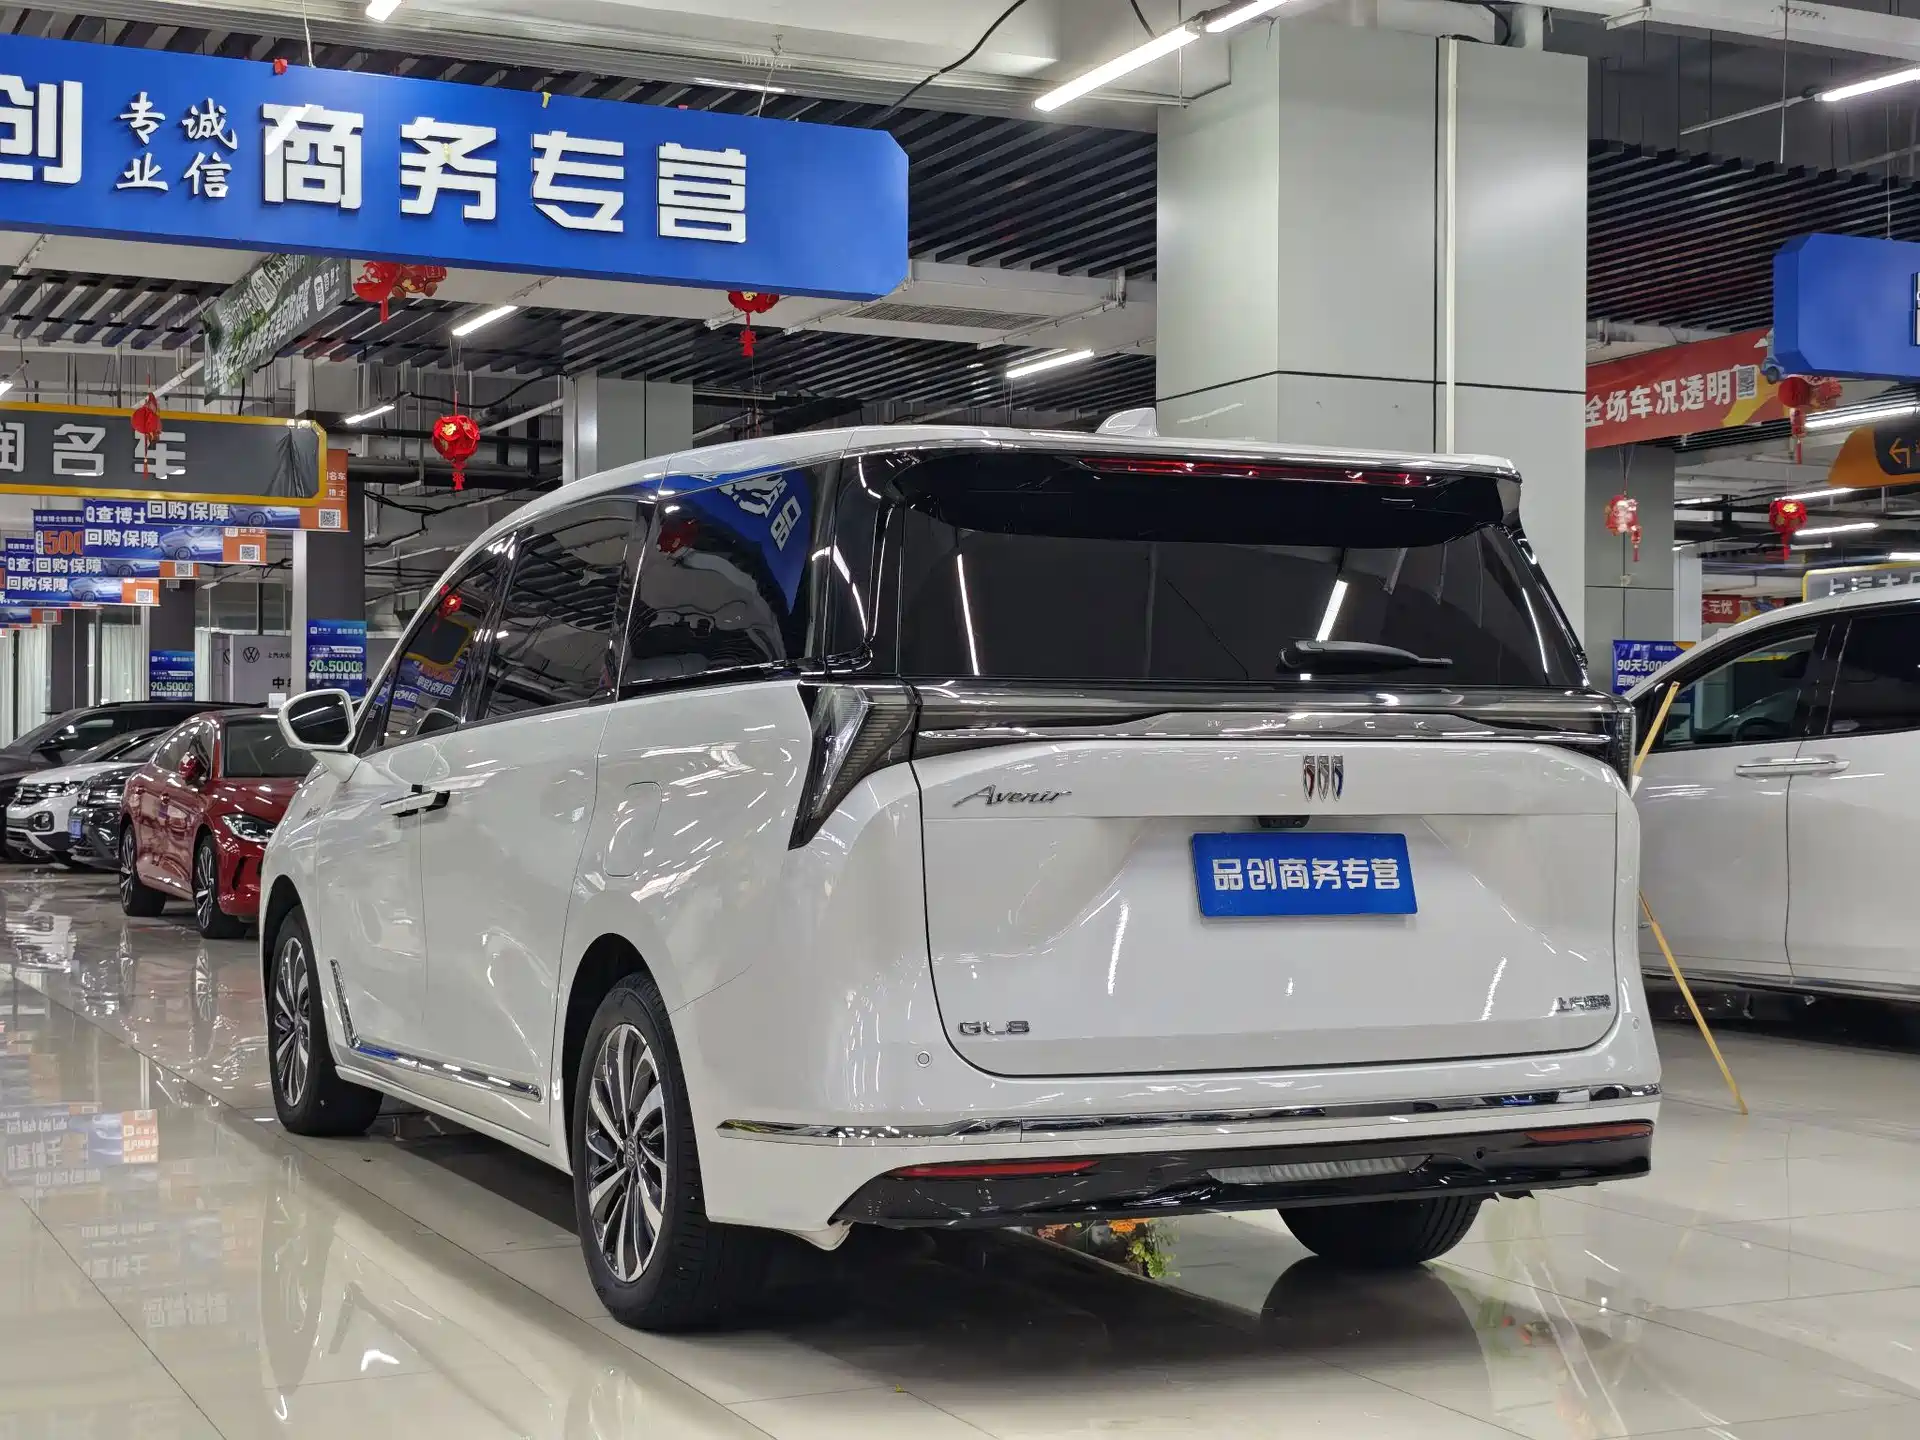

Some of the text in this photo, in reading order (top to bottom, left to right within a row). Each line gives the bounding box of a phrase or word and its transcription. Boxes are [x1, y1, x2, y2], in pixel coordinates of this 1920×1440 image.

[262, 103, 747, 243] 商务专营
[1586, 369, 1731, 427] 全场车况透明
[147, 500, 230, 522] 回购保障
[84, 528, 160, 548] 回购保障
[36, 557, 102, 573] 回购保障
[952, 785, 1072, 808] Avenir
[1212, 858, 1400, 891] 品创商务专营
[959, 1021, 1030, 1036] GL8
